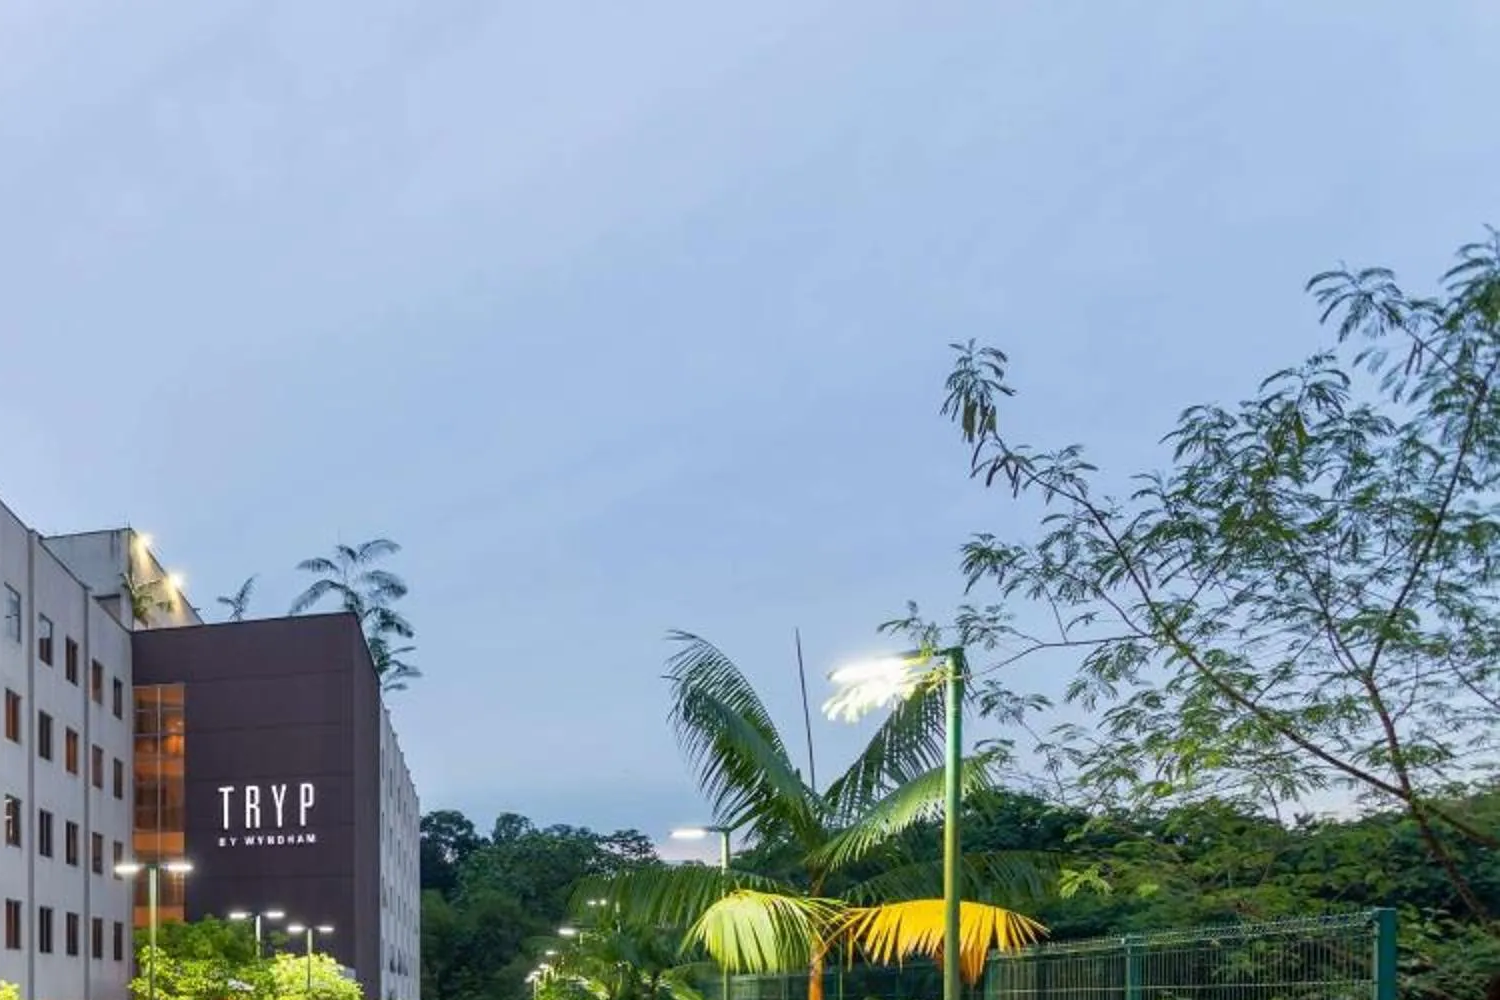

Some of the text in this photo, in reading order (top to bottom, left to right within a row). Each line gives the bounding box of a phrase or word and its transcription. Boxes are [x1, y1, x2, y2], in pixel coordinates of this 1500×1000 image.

[217, 782, 315, 830] TRYP
[218, 833, 316, 847] BY WYNDHAM
